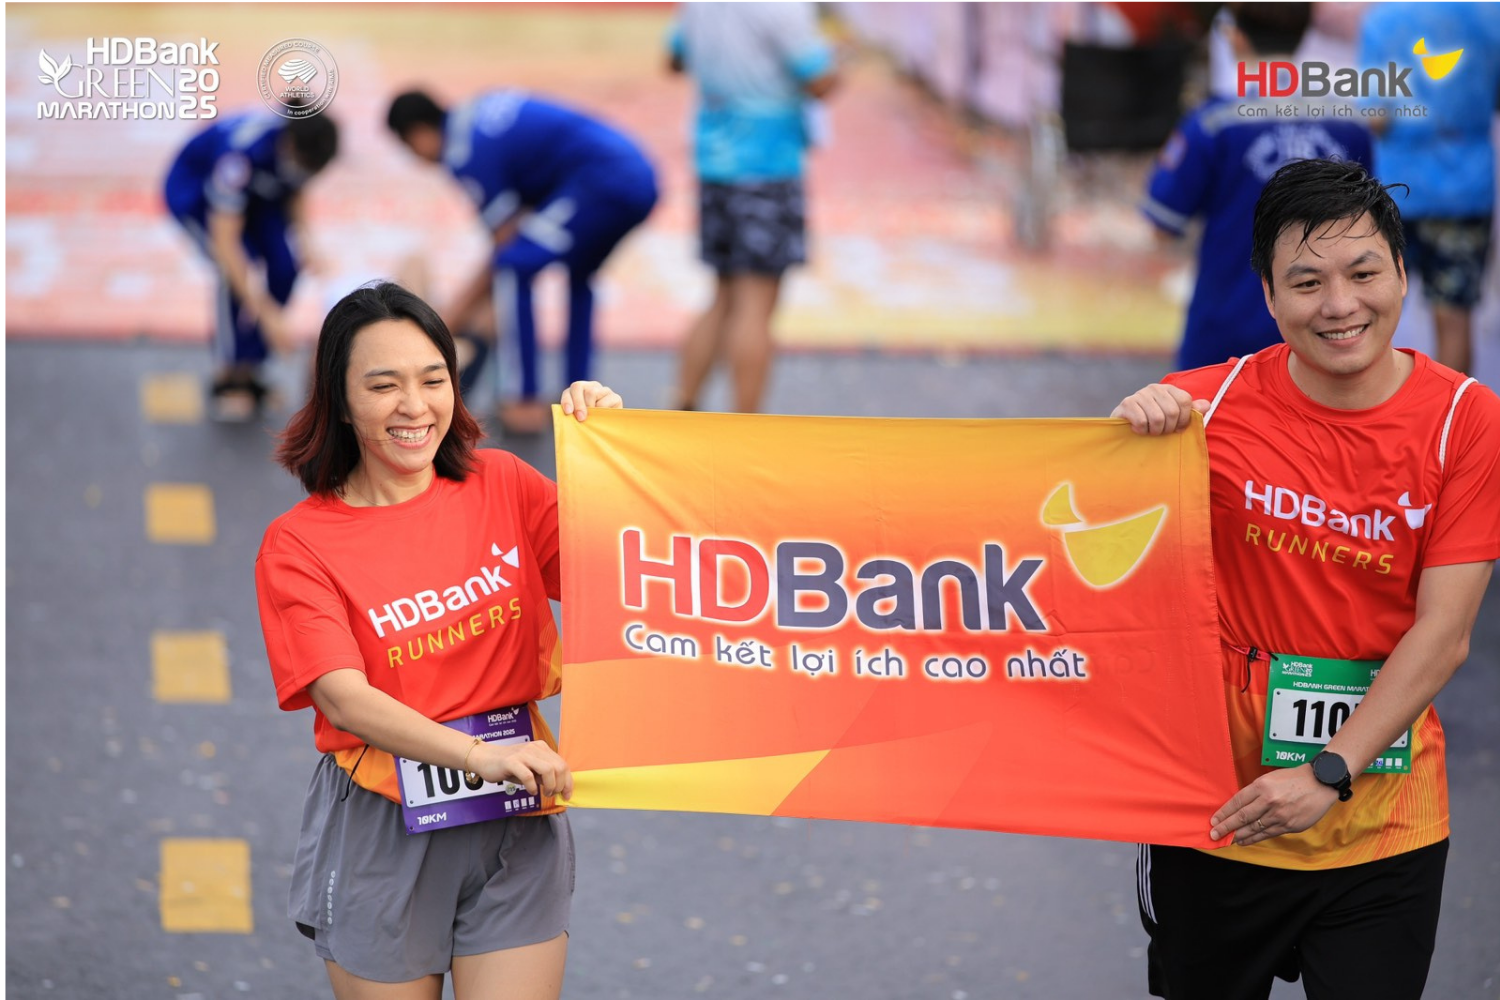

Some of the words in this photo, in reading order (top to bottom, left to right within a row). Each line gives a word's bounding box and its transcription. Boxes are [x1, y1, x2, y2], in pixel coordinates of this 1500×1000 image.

[1244, 480, 1396, 541] HDBank
[1245, 523, 1394, 575] RUNNERS
[367, 565, 512, 639] HDBank
[621, 529, 1047, 632] HDBank
[387, 597, 522, 668] RUNNERS
[624, 624, 697, 658] Cam
[715, 633, 772, 669] kết
[791, 644, 835, 677] lợi
[855, 647, 902, 677] ích
[924, 655, 987, 679] cao
[1007, 648, 1086, 679] nhất
[1293, 681, 1322, 689] HDBANK
[487, 711, 514, 723] HDBank
[503, 728, 515, 736] 2025
[1293, 699, 1362, 738] 110
[1276, 750, 1306, 762] 10KM
[417, 812, 447, 826] 10KM
